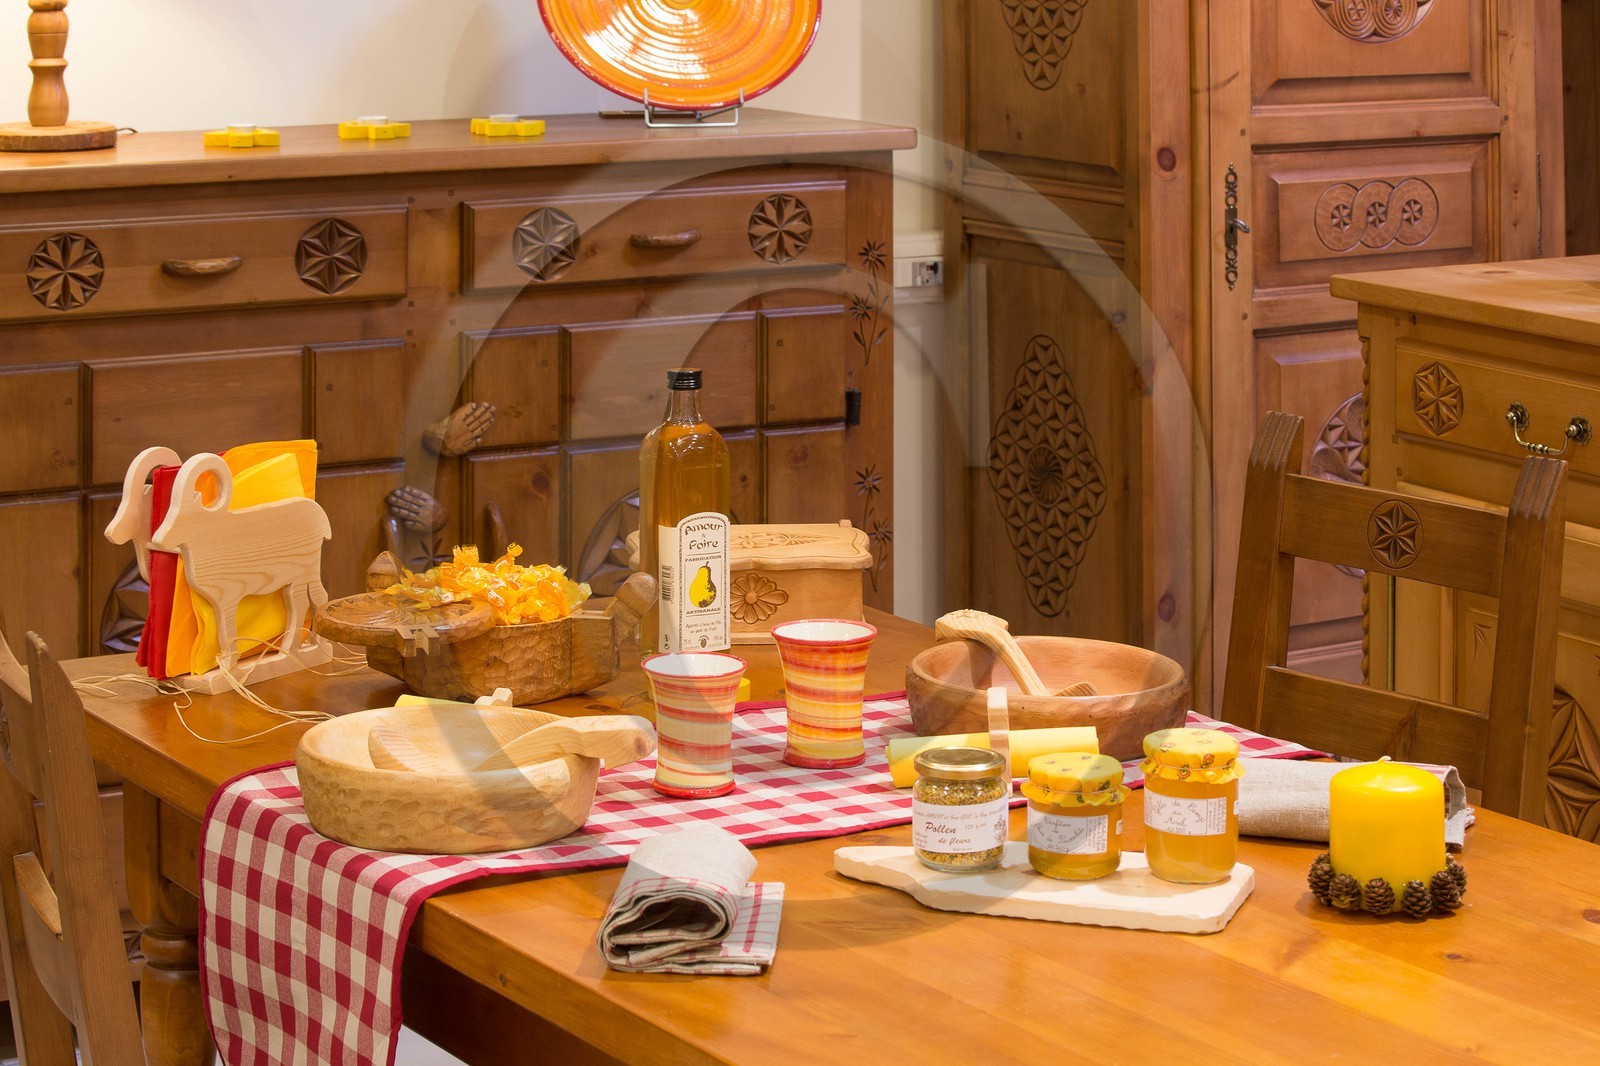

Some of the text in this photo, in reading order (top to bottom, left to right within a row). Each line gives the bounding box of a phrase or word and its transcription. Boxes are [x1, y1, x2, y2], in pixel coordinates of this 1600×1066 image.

[685, 523, 723, 536] Amour
[689, 539, 718, 550] Poire
[686, 607, 721, 615] ARTISANALE
[925, 821, 957, 834] Pollen
[949, 837, 971, 846] fleurs
